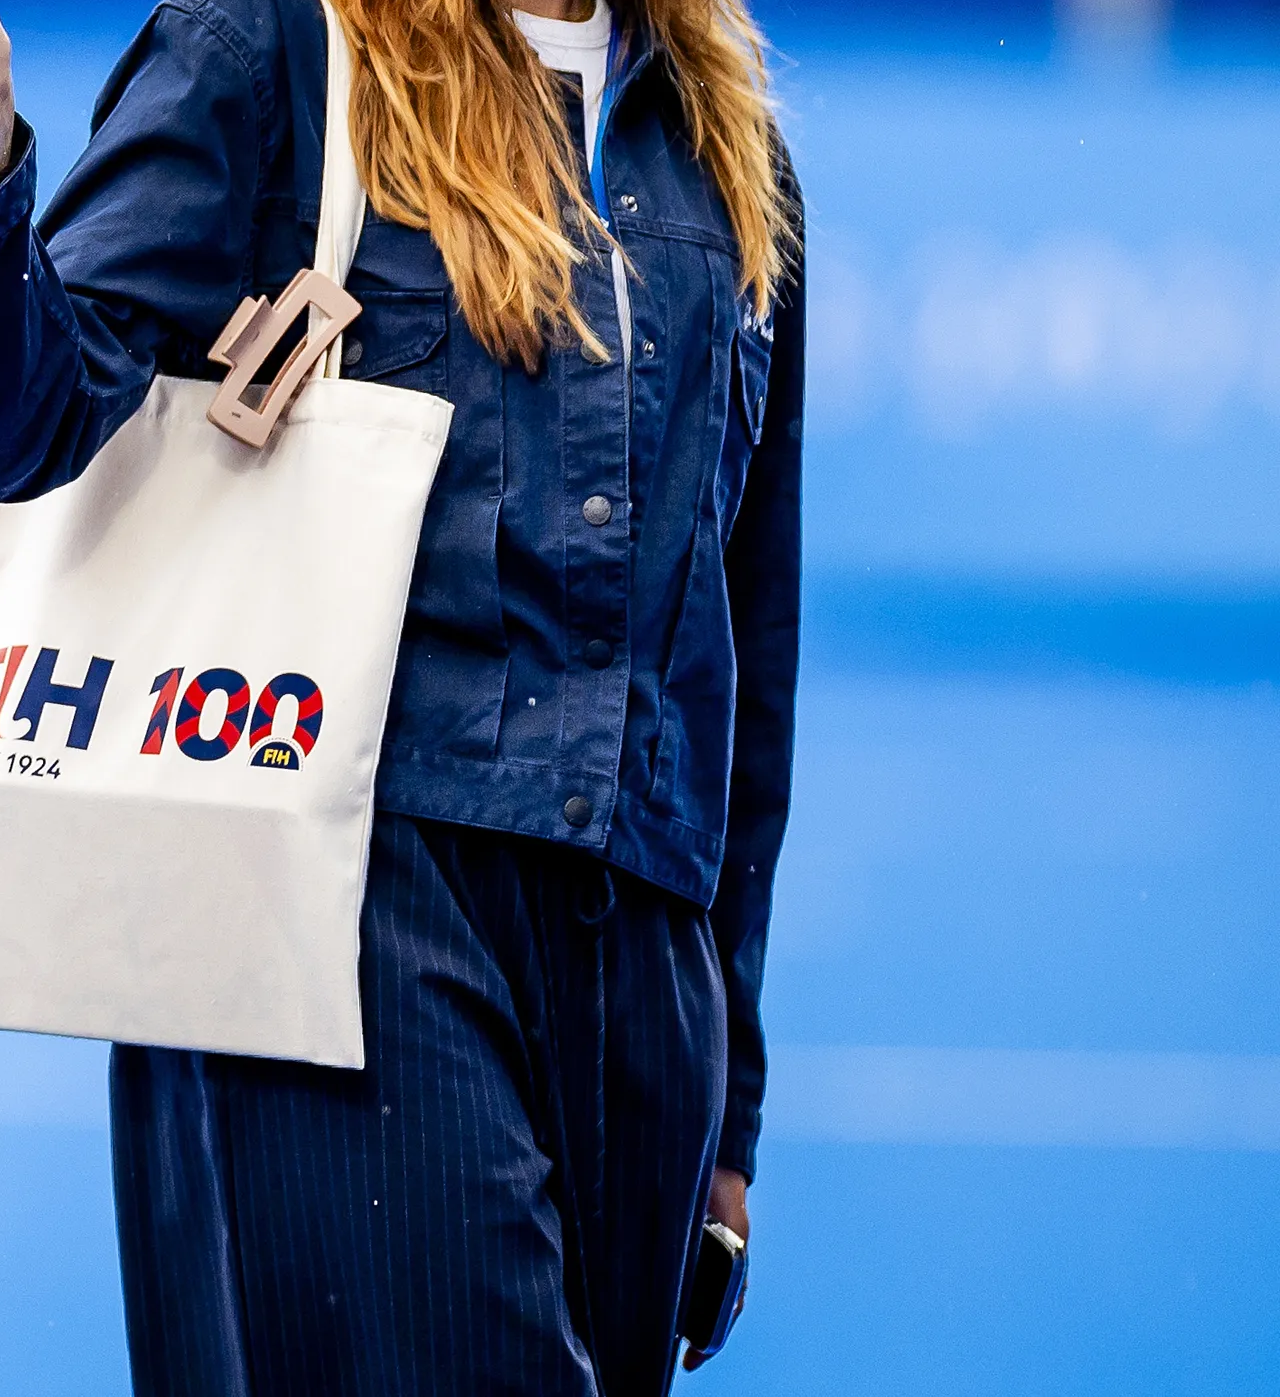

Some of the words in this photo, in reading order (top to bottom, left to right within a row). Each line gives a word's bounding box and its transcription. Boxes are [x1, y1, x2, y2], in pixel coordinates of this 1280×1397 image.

[139, 666, 324, 762] 100
[6, 753, 62, 780] 1924
[262, 748, 291, 766] FIH
